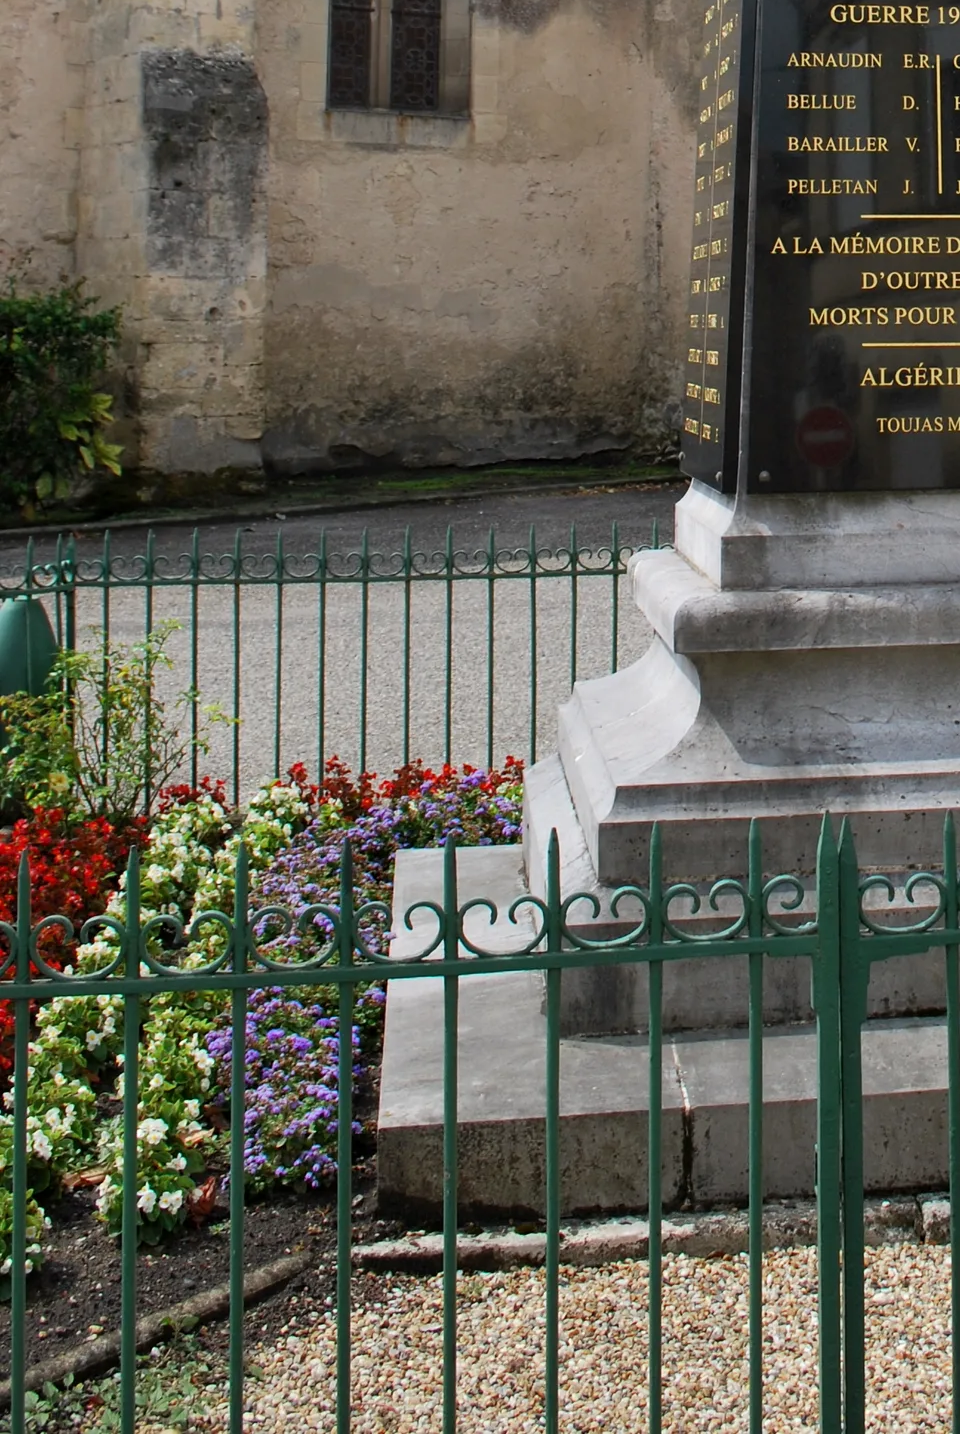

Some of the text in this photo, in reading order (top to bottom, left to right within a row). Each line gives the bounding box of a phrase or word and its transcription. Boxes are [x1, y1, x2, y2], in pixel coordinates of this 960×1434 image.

[829, 4, 931, 26] GUERRE
[787, 53, 935, 69] ARNAUDIN E.R.
[786, 94, 922, 111] BELLUE D.
[787, 137, 921, 153] BARAILLER V.
[787, 179, 915, 195] PELLETAN J.
[770, 237, 788, 255] A
[792, 237, 825, 255] LA
[829, 232, 942, 255] MÉMOIRE
[808, 307, 890, 327] MORTS
[893, 307, 958, 327] POUR
[875, 417, 944, 434] TOUJAS
